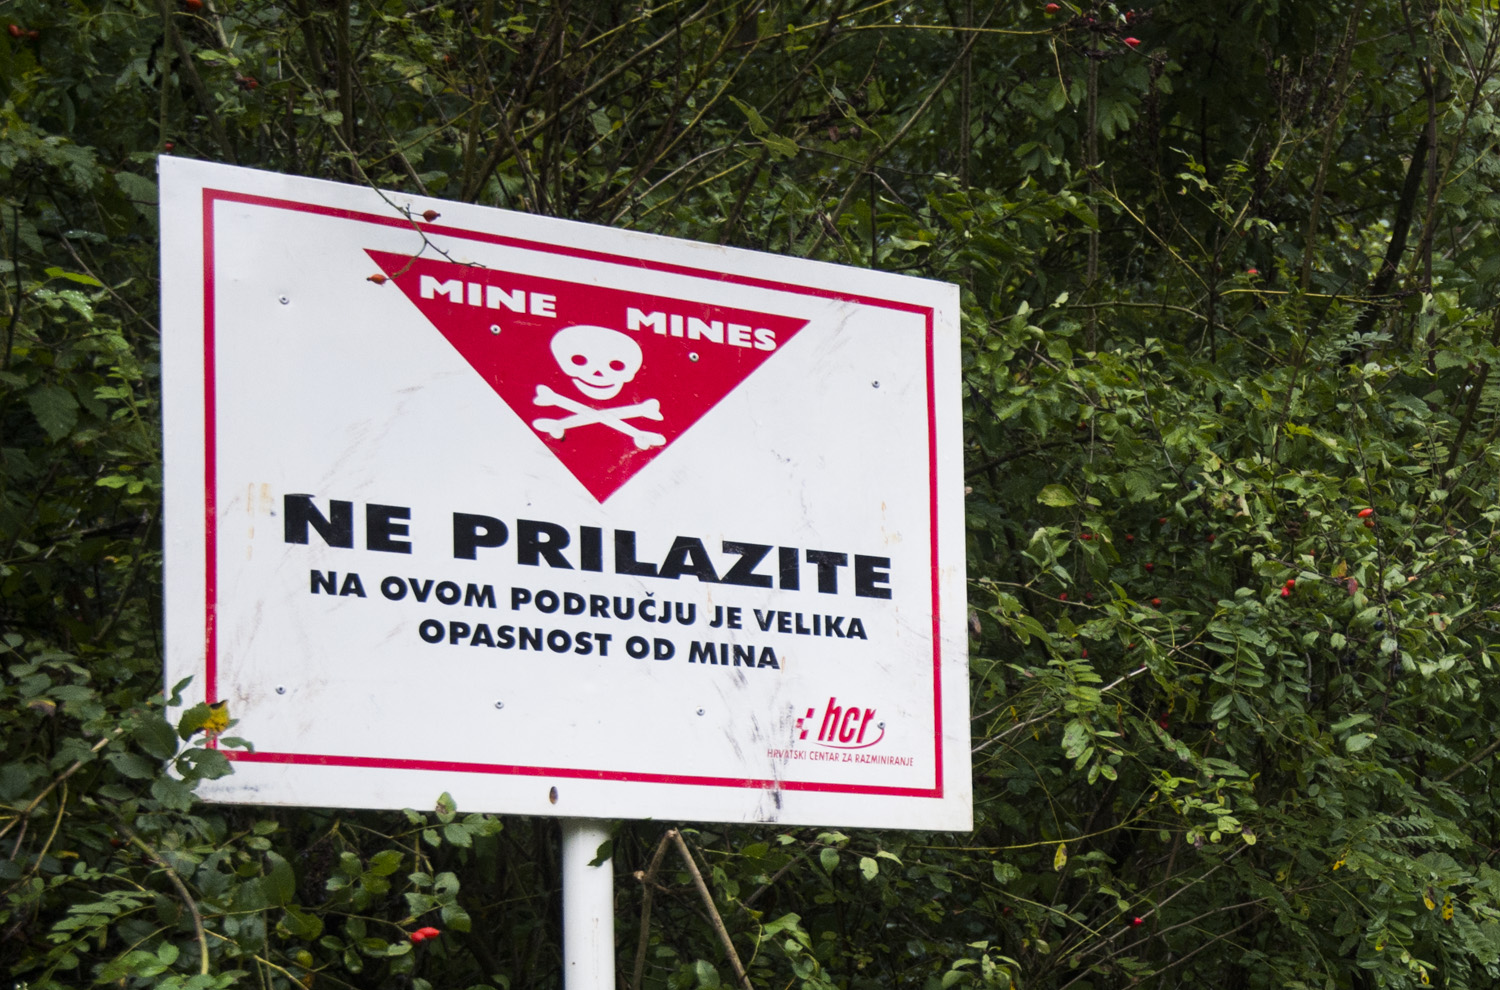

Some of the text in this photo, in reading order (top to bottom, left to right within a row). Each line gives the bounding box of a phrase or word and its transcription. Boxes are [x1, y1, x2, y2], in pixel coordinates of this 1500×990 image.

[420, 275, 777, 352] MINE MINES
[283, 493, 893, 600] NE PRILAZITE
[310, 569, 868, 640] NA OVOM PODRUČJU JE VELIKA
[418, 618, 781, 670] OPASNOST OD MINA
[818, 697, 877, 744] hcr
[767, 748, 914, 767] HRVATSKI CENTAR ZA RAZMINIRANJE
